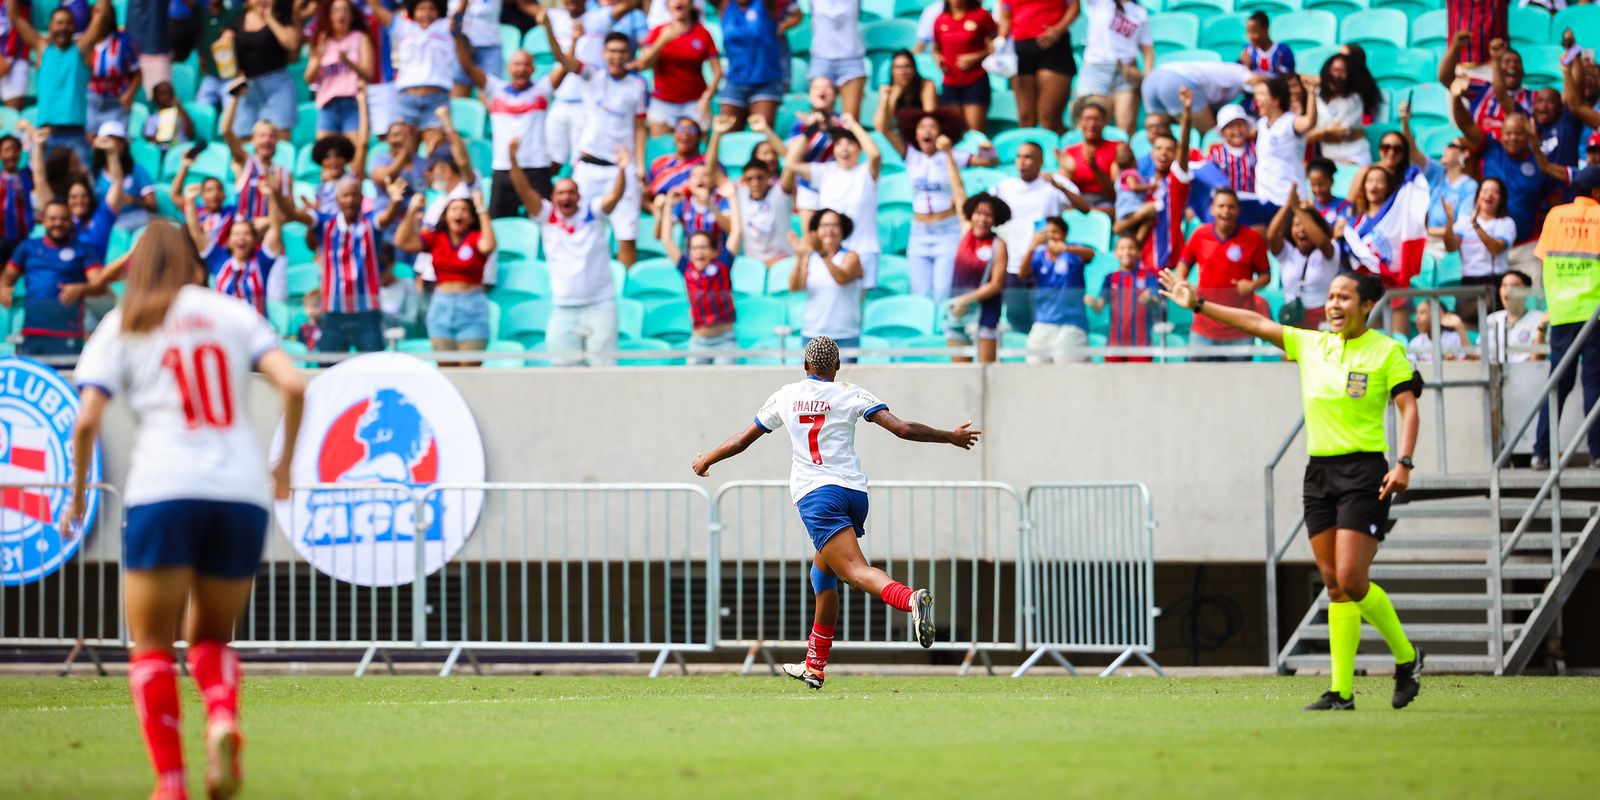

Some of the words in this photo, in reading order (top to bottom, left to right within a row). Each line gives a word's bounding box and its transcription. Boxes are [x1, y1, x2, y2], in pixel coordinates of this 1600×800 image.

[161, 343, 233, 430] 10
[792, 400, 831, 413] RHAIZZA
[799, 414, 825, 466] 7
